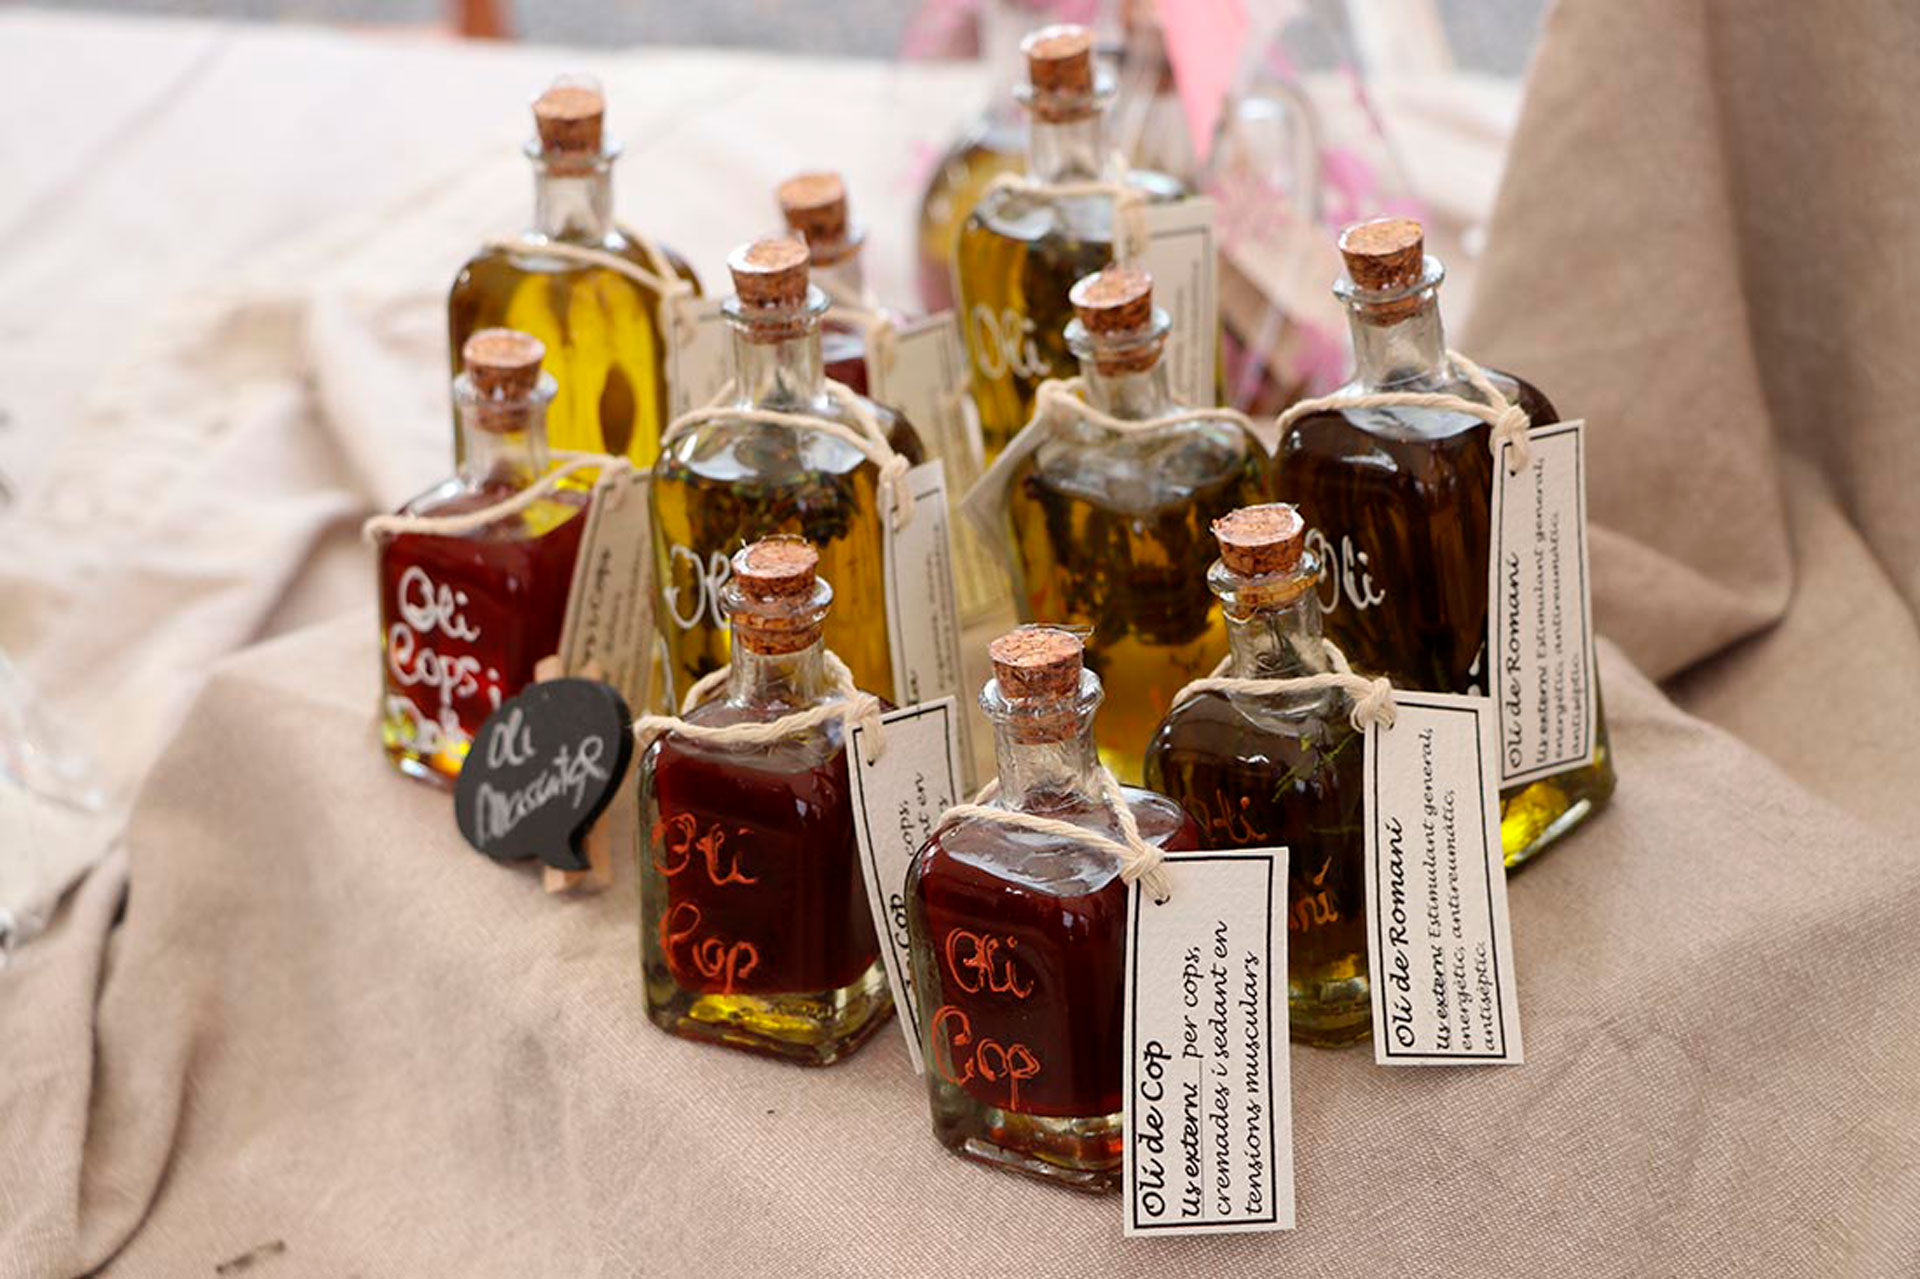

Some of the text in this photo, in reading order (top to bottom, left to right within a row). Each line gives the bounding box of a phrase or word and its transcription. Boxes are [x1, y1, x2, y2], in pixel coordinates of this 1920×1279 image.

[973, 304, 1051, 380] Oli
[398, 565, 481, 642] Oli
[1534, 549, 1549, 660] Estimulant
[389, 622, 481, 706] Cops
[1504, 679, 1521, 720] de
[1419, 727, 1438, 818] general,
[652, 812, 758, 885] Oli
[1421, 821, 1443, 939] Estimulant
[660, 902, 758, 995] Cop
[946, 927, 1034, 998] Oli
[1183, 946, 1204, 1008] cops,
[1388, 950, 1411, 990] de
[931, 1005, 1040, 1111] Cop
[1183, 1015, 1205, 1059] per
[1392, 992, 1415, 1048] Oli
[1208, 920, 1231, 1216] cremades i sedant en
[1239, 950, 1263, 1215] tensions musculars
[1138, 1039, 1172, 1218] Oli de Cop
[1182, 1179, 1201, 1218] Us
